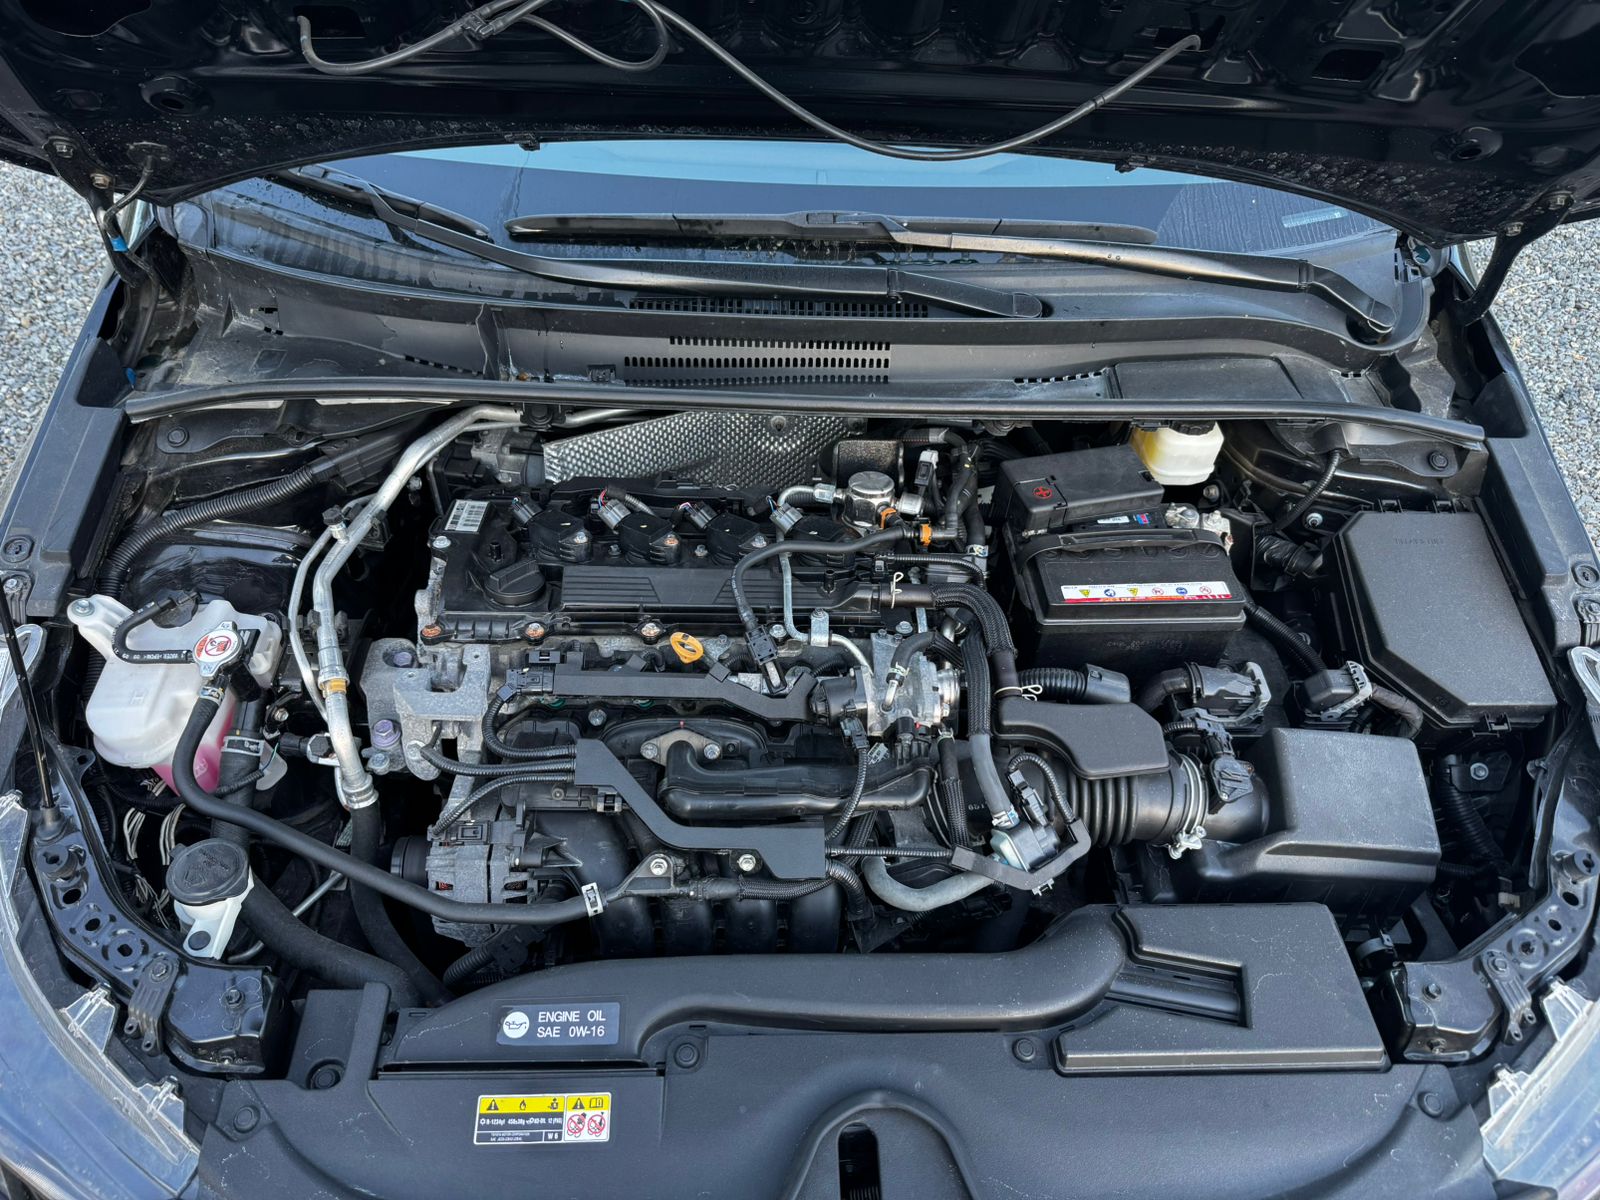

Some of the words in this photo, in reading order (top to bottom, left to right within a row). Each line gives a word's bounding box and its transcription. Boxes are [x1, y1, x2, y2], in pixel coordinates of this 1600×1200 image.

[538, 1011, 580, 1022] ENGINE
[587, 1010, 606, 1021] OIL
[536, 1027, 561, 1038] SAE
[568, 1026, 605, 1037] 0W-16
